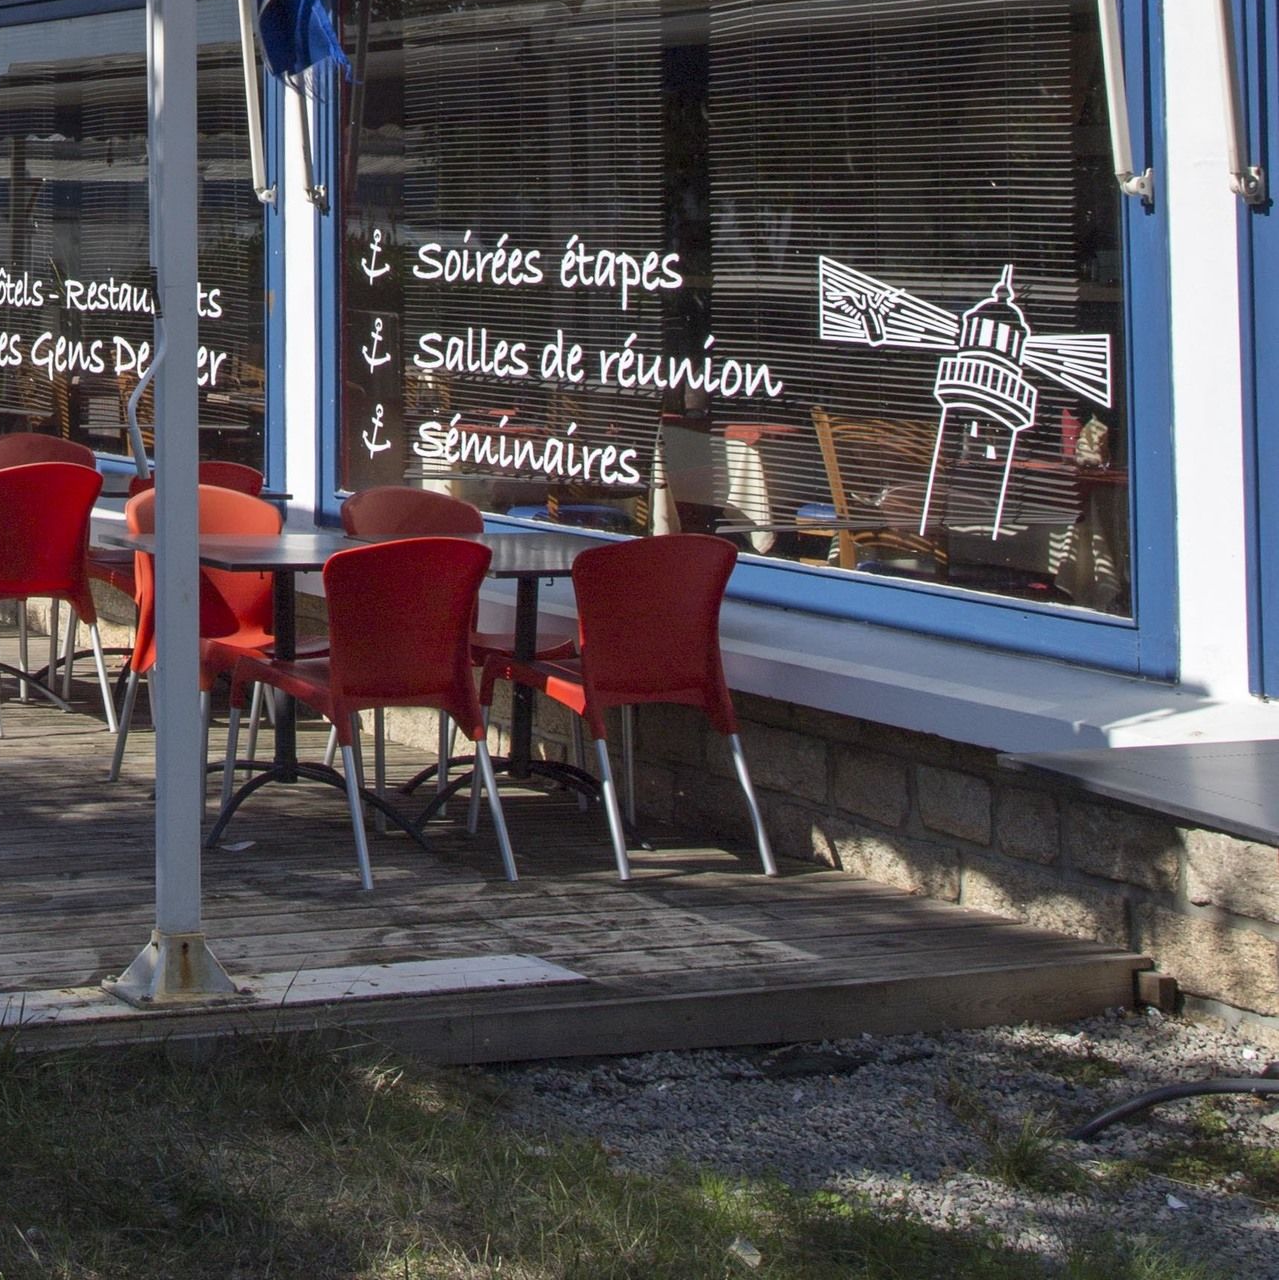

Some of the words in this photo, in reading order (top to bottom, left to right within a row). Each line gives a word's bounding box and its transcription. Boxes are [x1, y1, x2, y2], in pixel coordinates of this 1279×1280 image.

[64, 277, 223, 318] Restauts
[413, 229, 544, 286] Soirées
[560, 234, 683, 311] étapes
[31, 332, 105, 381] Gens
[114, 336, 150, 380] De
[197, 346, 227, 386] er
[413, 327, 528, 378] Salles
[540, 328, 584, 382] de
[599, 333, 783, 397] réunion
[413, 413, 641, 484] Séminaires
